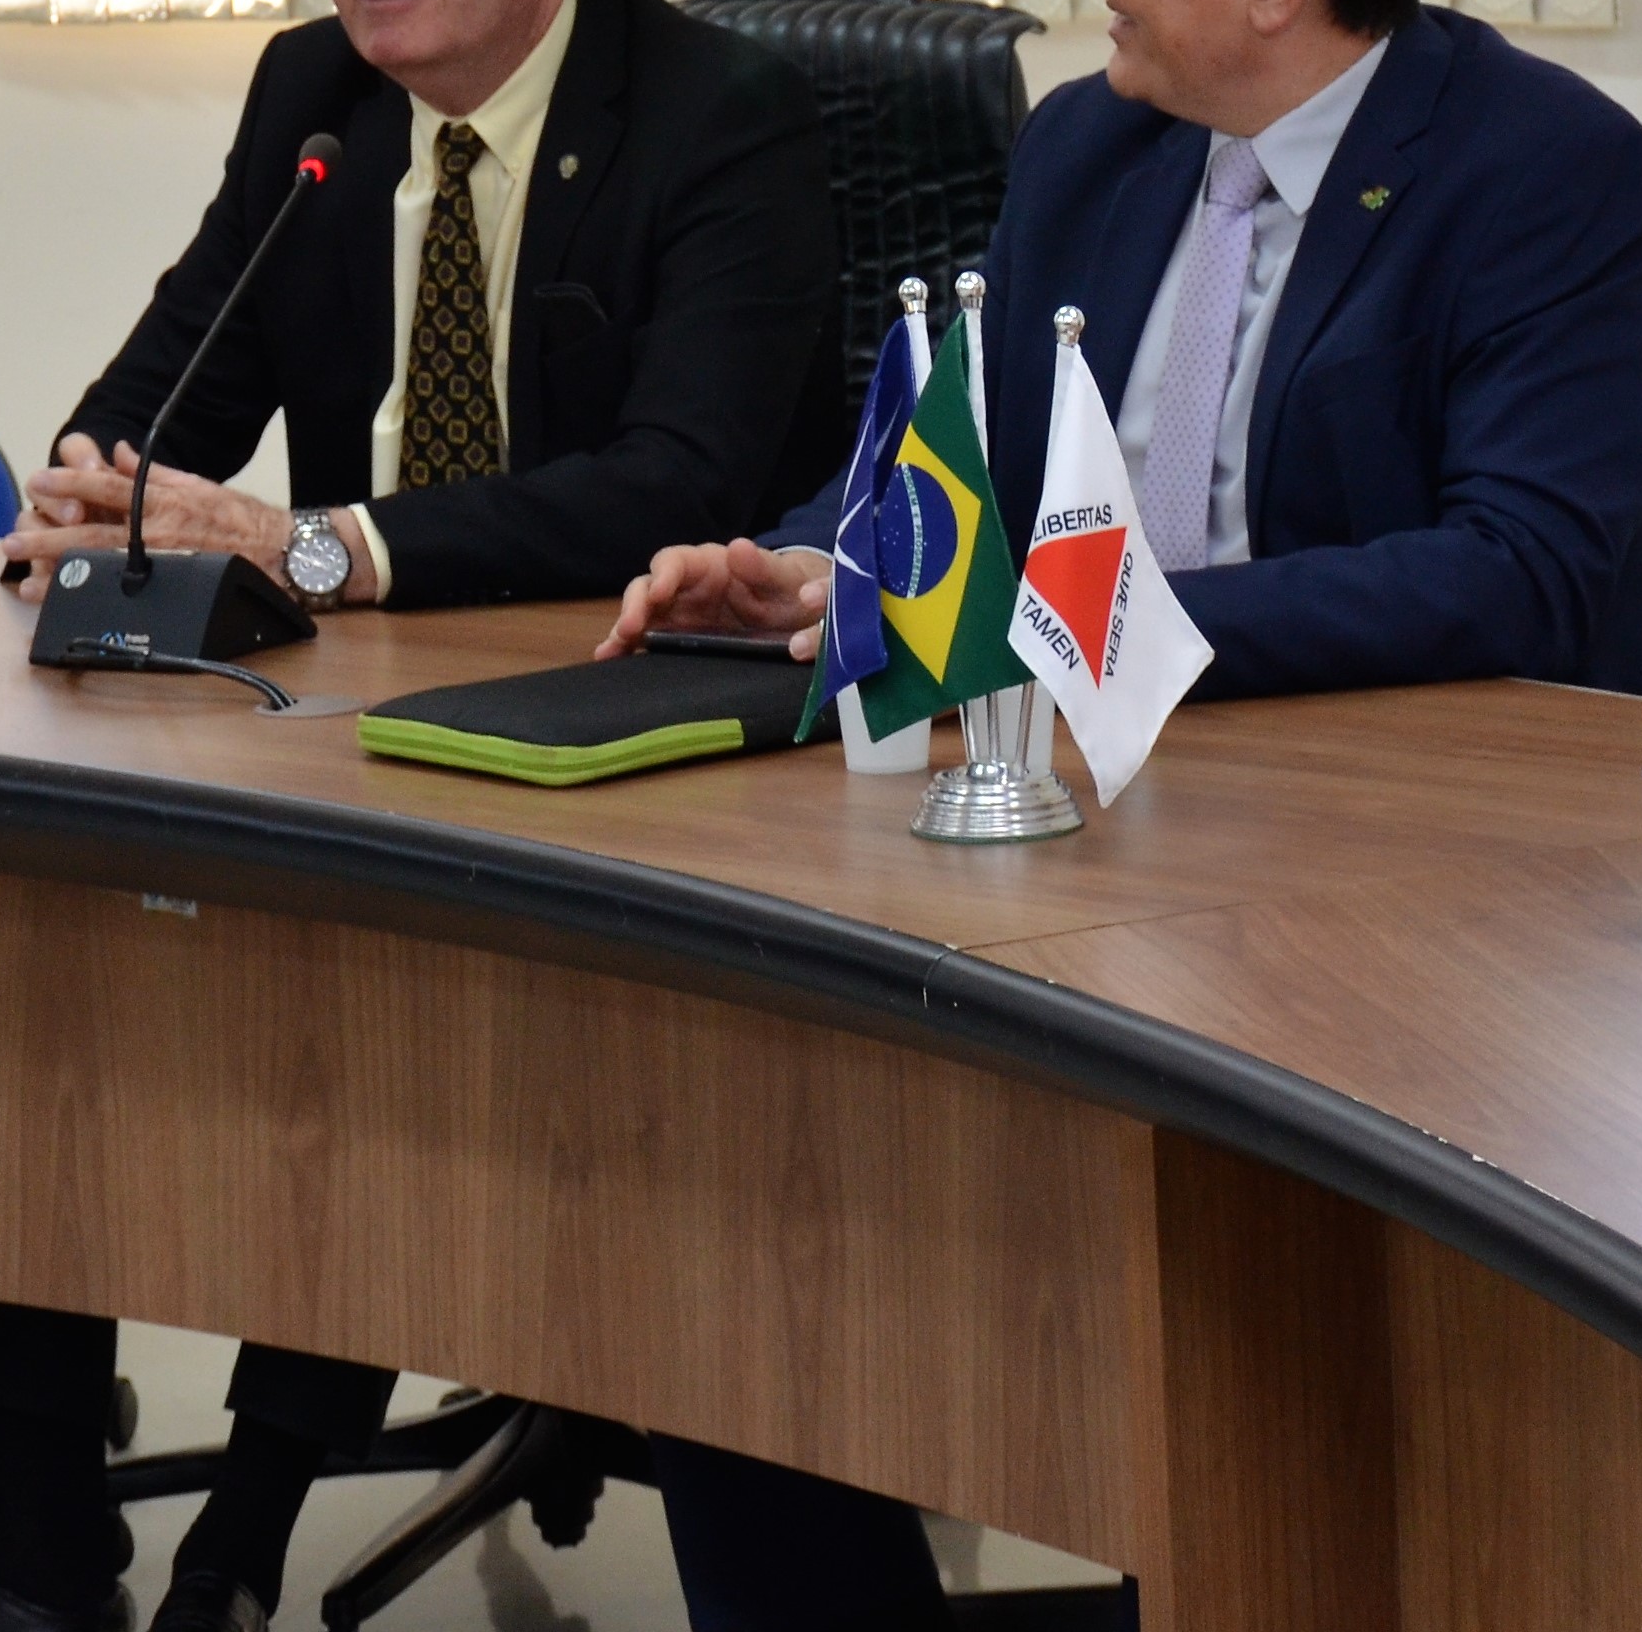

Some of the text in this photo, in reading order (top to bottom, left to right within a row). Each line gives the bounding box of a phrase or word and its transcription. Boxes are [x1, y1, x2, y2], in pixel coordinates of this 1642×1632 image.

[1033, 504, 1113, 541] LIBERTAS
[1020, 594, 1080, 670] TAMEN
[1104, 614, 1124, 677] SERA
